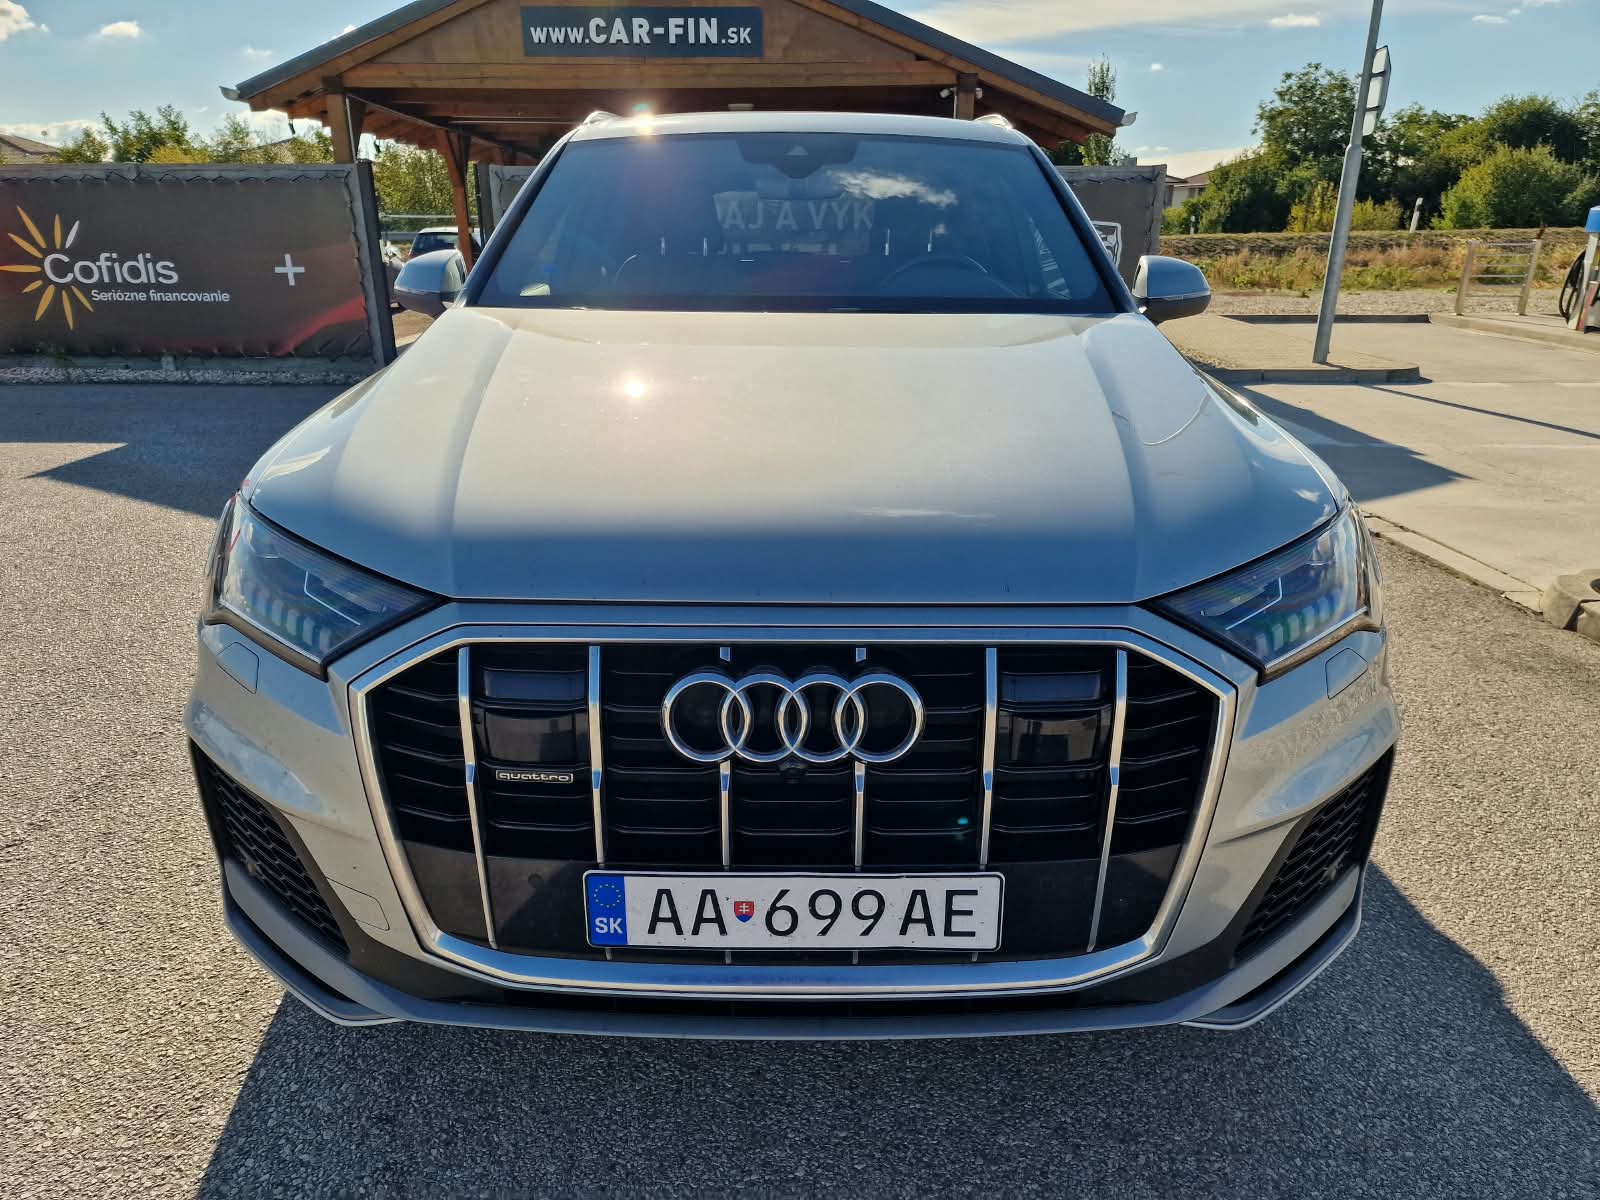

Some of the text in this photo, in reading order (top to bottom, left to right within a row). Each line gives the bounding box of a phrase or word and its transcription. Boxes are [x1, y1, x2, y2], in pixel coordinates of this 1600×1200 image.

[43, 253, 179, 285] Cofidis
[91, 289, 231, 303] Seriózne financovanie
[499, 771, 570, 781] quattro
[594, 917, 624, 935] SK
